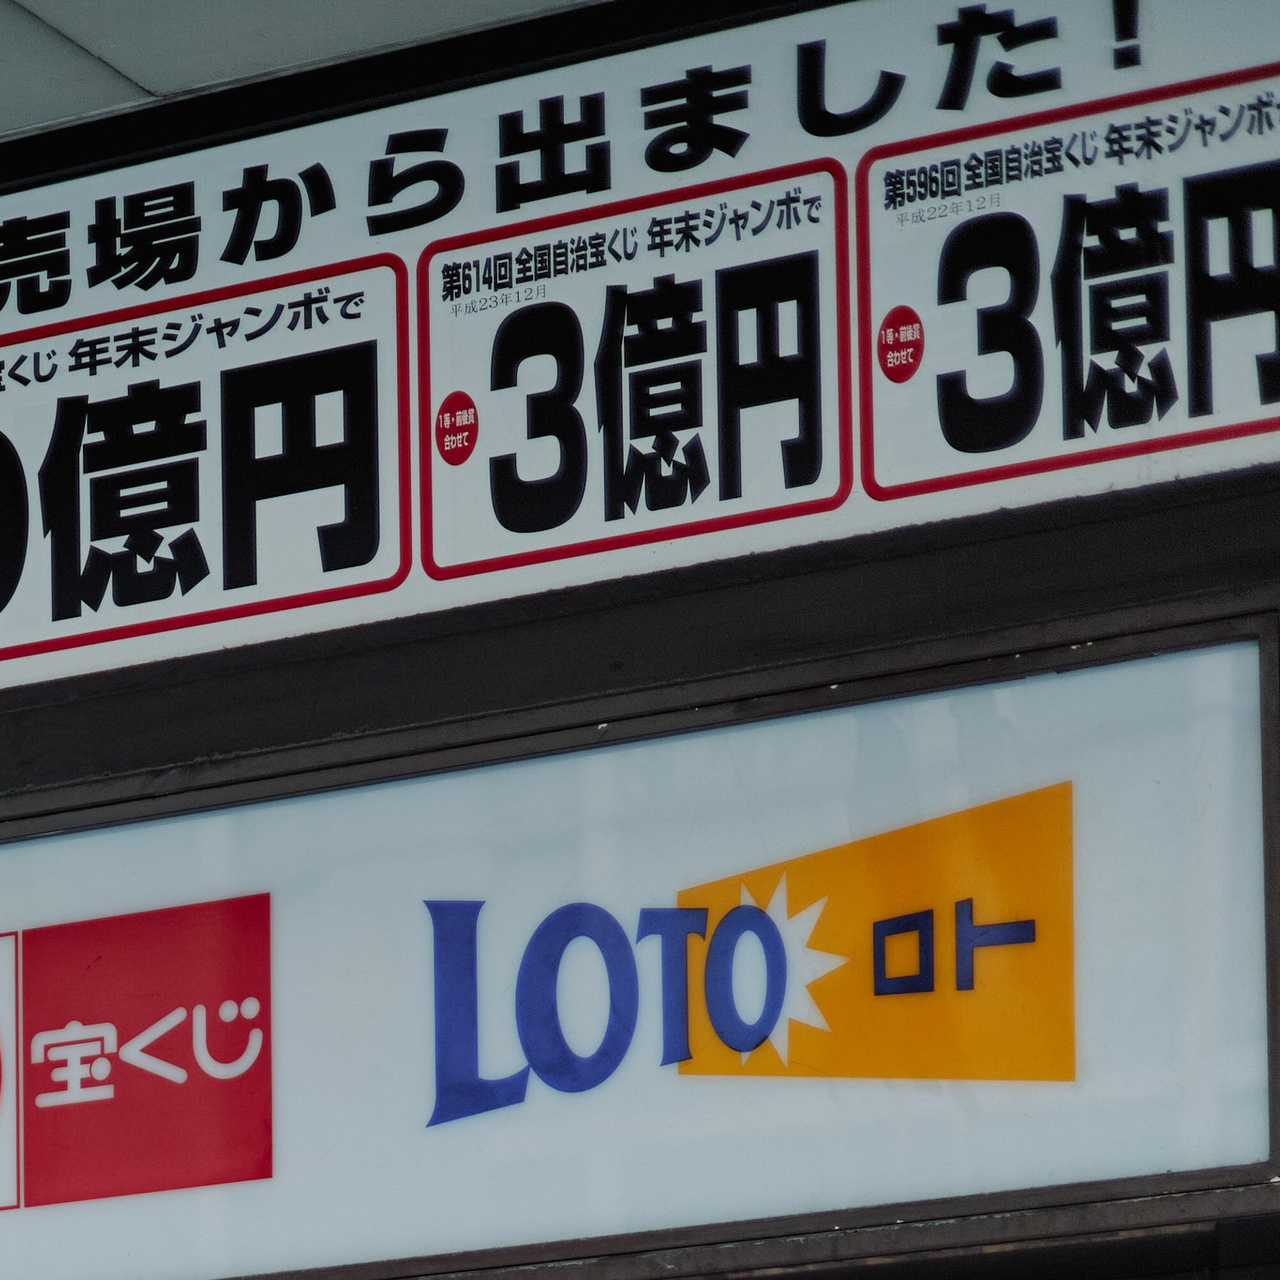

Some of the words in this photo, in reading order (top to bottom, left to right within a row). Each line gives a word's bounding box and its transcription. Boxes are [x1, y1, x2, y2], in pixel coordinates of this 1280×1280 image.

[883, 159, 963, 211] 第596回
[965, 131, 1098, 192] 全国自治宝くじ
[1105, 91, 1280, 165] 年末ジャンボ
[441, 255, 513, 302] 第614回
[515, 231, 639, 285] 全国自治宝くじ
[647, 186, 823, 258] 年末ジャンボで
[894, 193, 1003, 227] 平成22年12月
[68, 286, 366, 377] 年末ジャンボで
[449, 283, 548, 317] 平成23年12月
[937, 161, 1280, 453] 3億円
[490, 249, 823, 533] 3億円
[886, 344, 915, 368] 合わせて
[443, 428, 470, 451] 合わせて
[874, 898, 1036, 995] ロト
[31, 997, 264, 1109] 宝くじ
[423, 900, 788, 1128] LOTO
